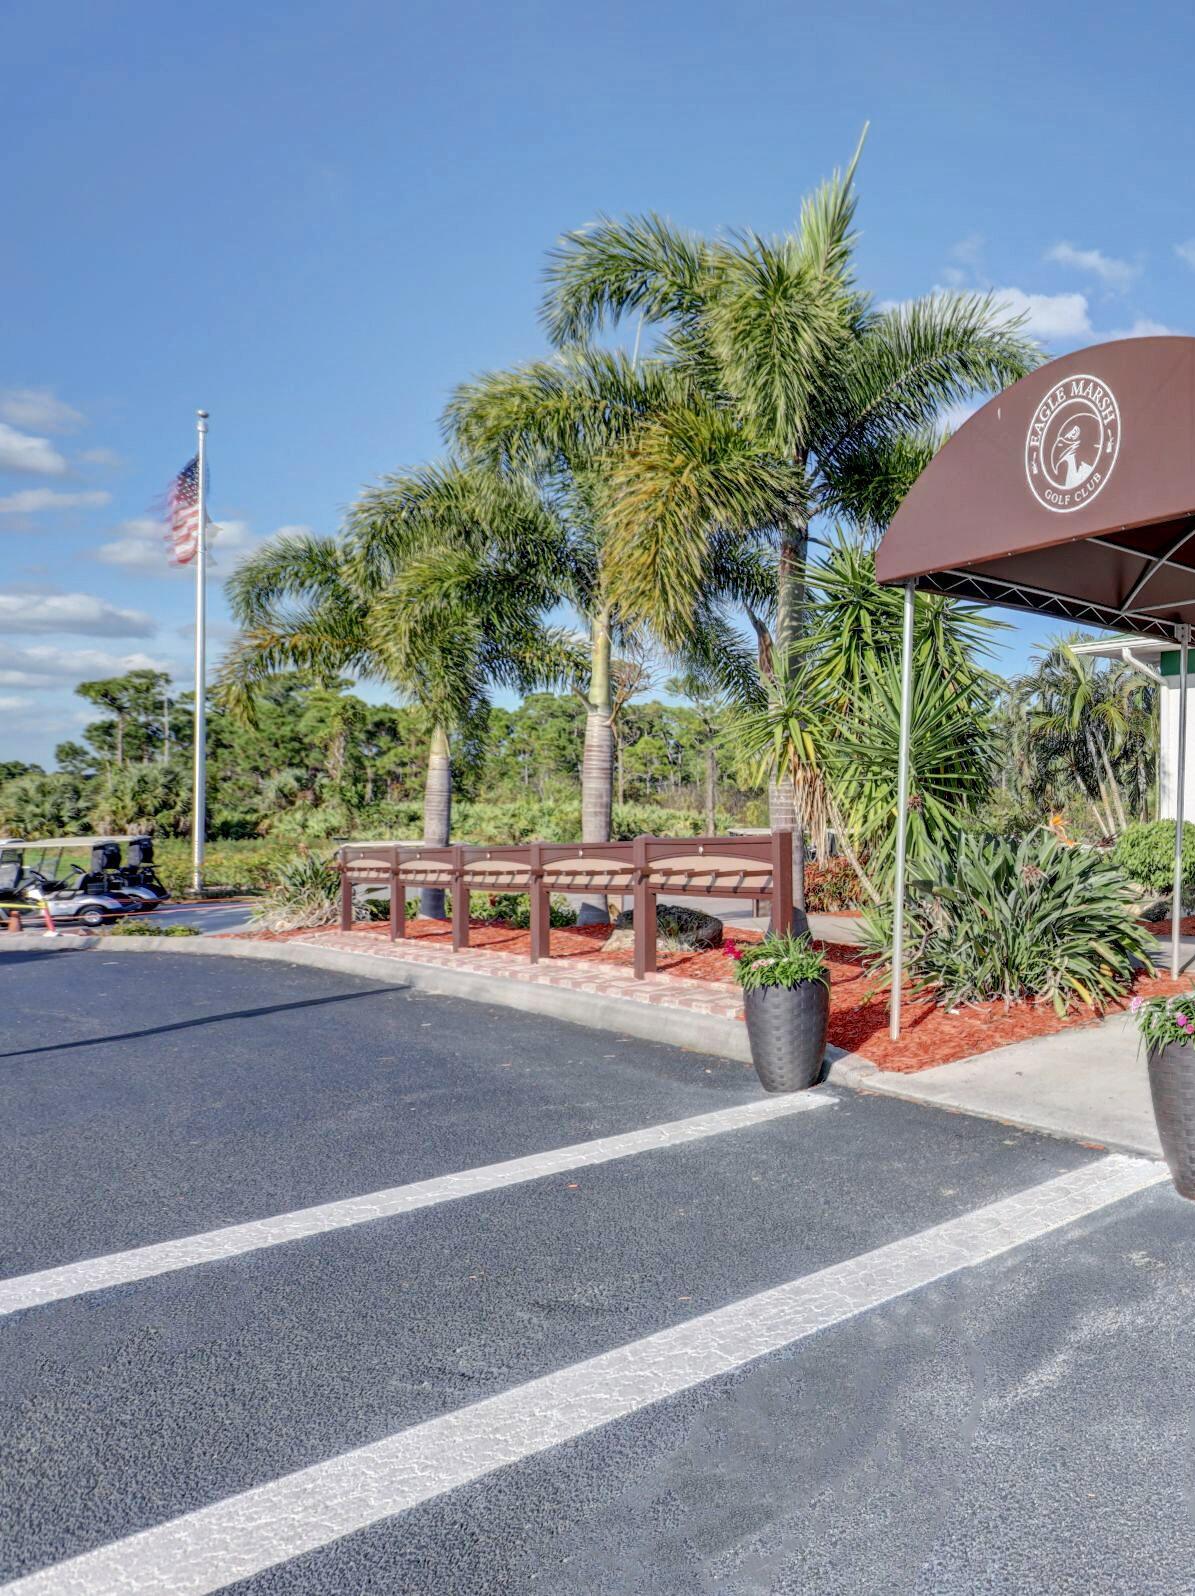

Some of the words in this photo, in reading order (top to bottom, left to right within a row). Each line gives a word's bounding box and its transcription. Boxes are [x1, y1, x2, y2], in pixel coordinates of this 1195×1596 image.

[1030, 387, 1067, 447] EAGLE
[1070, 379, 1116, 426] MARSH
[1044, 488, 1071, 505] GOLF
[1074, 472, 1102, 502] CLUB
